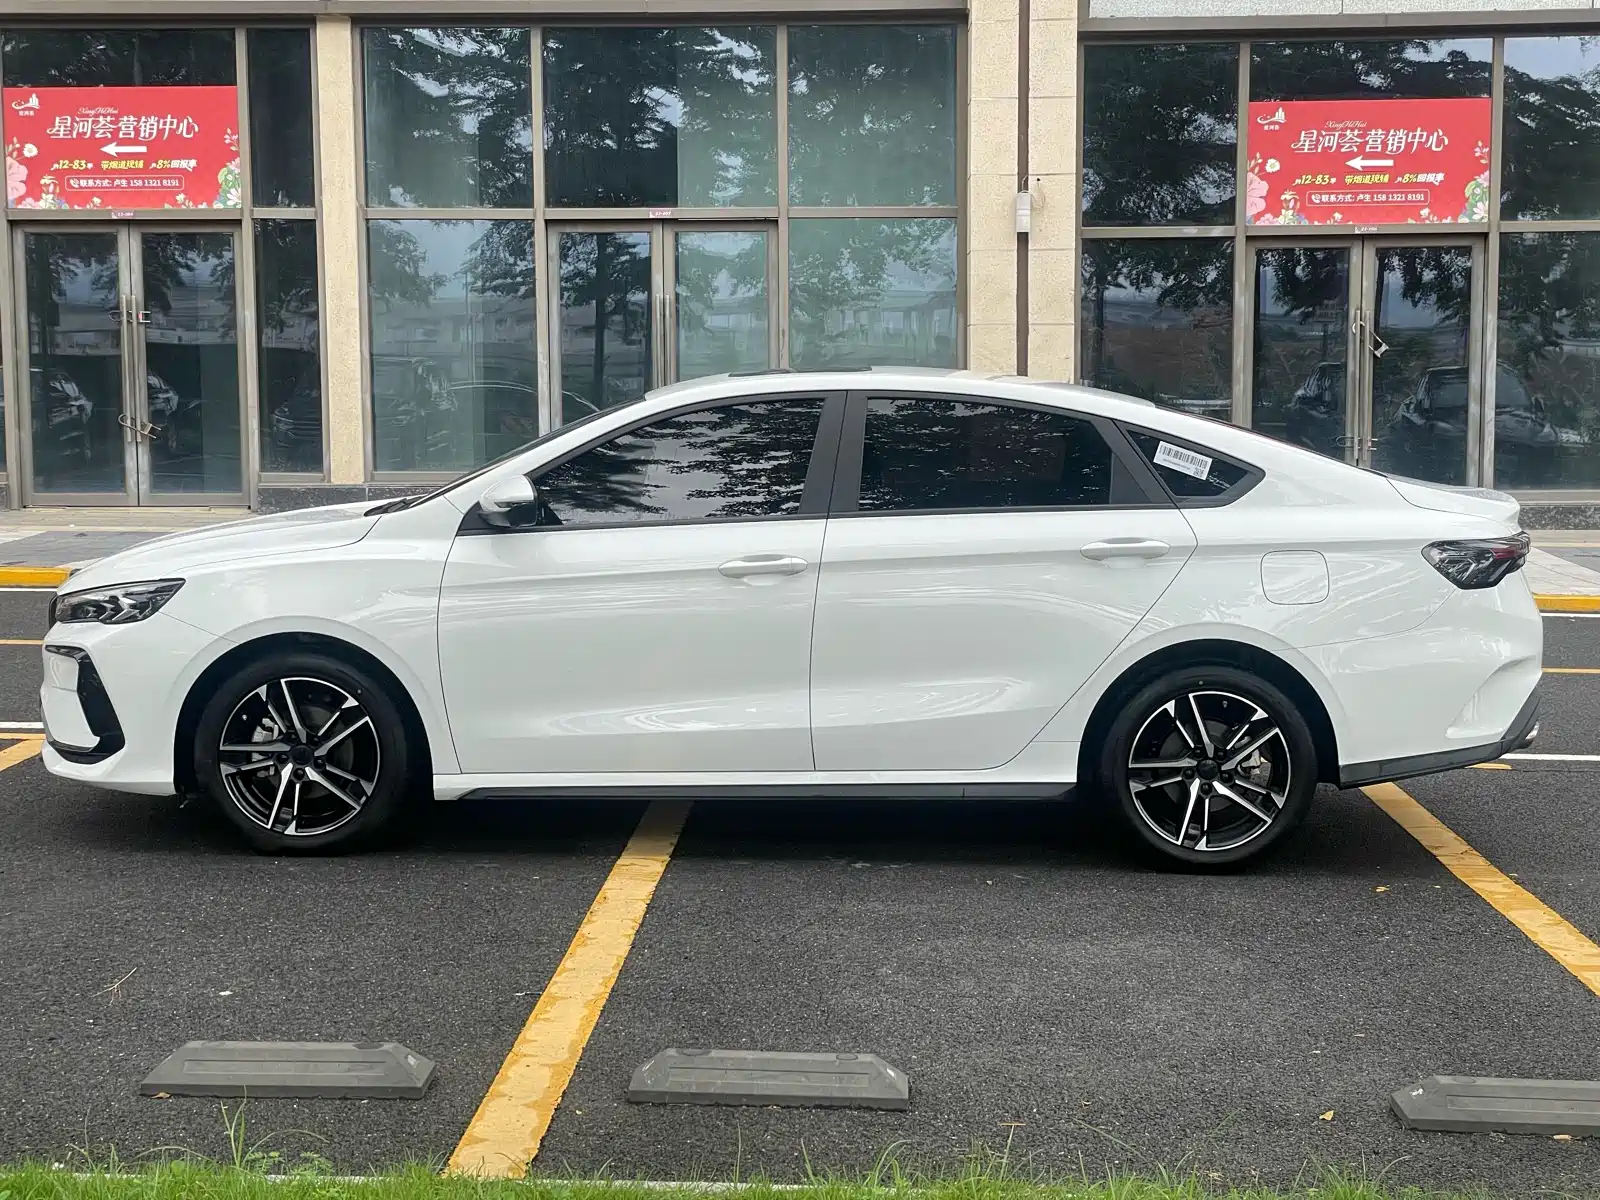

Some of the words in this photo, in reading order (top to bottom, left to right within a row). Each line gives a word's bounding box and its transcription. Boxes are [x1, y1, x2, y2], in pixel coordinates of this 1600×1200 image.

[46, 115, 199, 141] 星河荟营销中心
[1291, 127, 1449, 155] 星河荟营销中心
[130, 179, 143, 187] 158
[144, 179, 161, 187] 1321
[1373, 193, 1387, 201] 158
[1388, 193, 1406, 201] 1321
